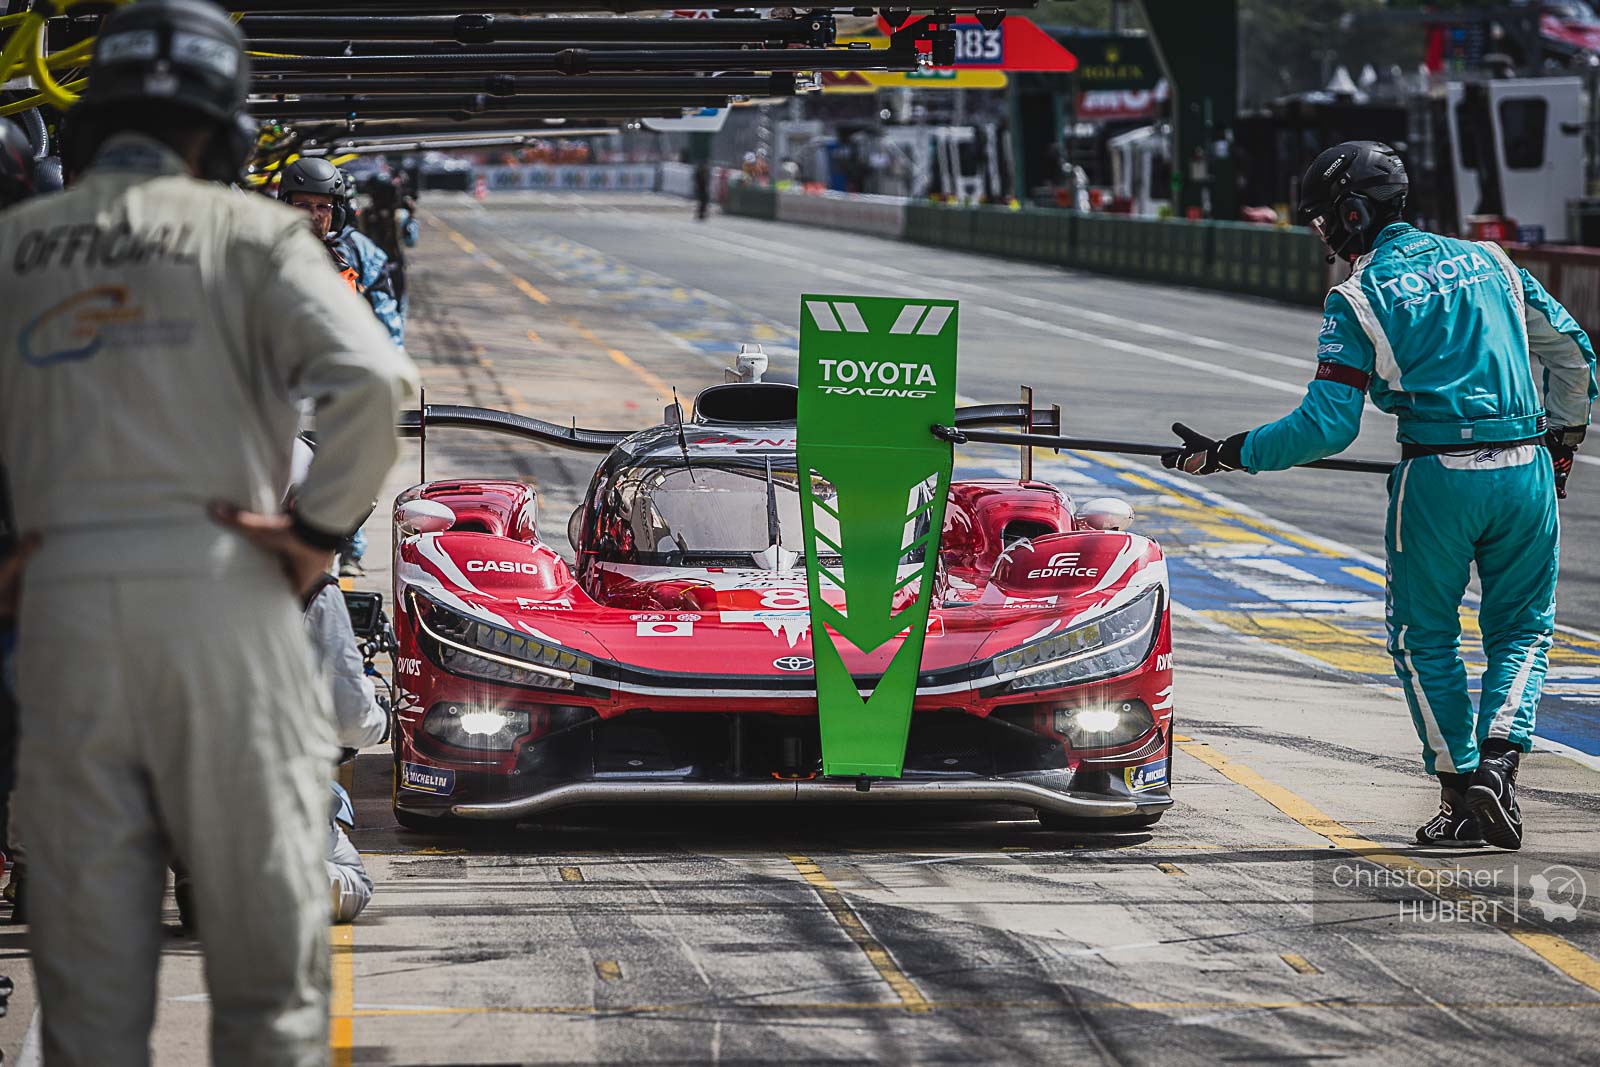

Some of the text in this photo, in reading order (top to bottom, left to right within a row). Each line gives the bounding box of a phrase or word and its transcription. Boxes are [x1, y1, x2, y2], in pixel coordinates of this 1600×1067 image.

[1380, 252, 1491, 298] TOYOTA
[818, 359, 937, 386] TOYOTA
[817, 385, 937, 399] RACING
[692, 437, 797, 447] DEN
[466, 560, 538, 575] CASIO
[1027, 567, 1099, 579] EDIFICE
[759, 588, 811, 609] 8
[409, 770, 448, 787] MICHELIN
